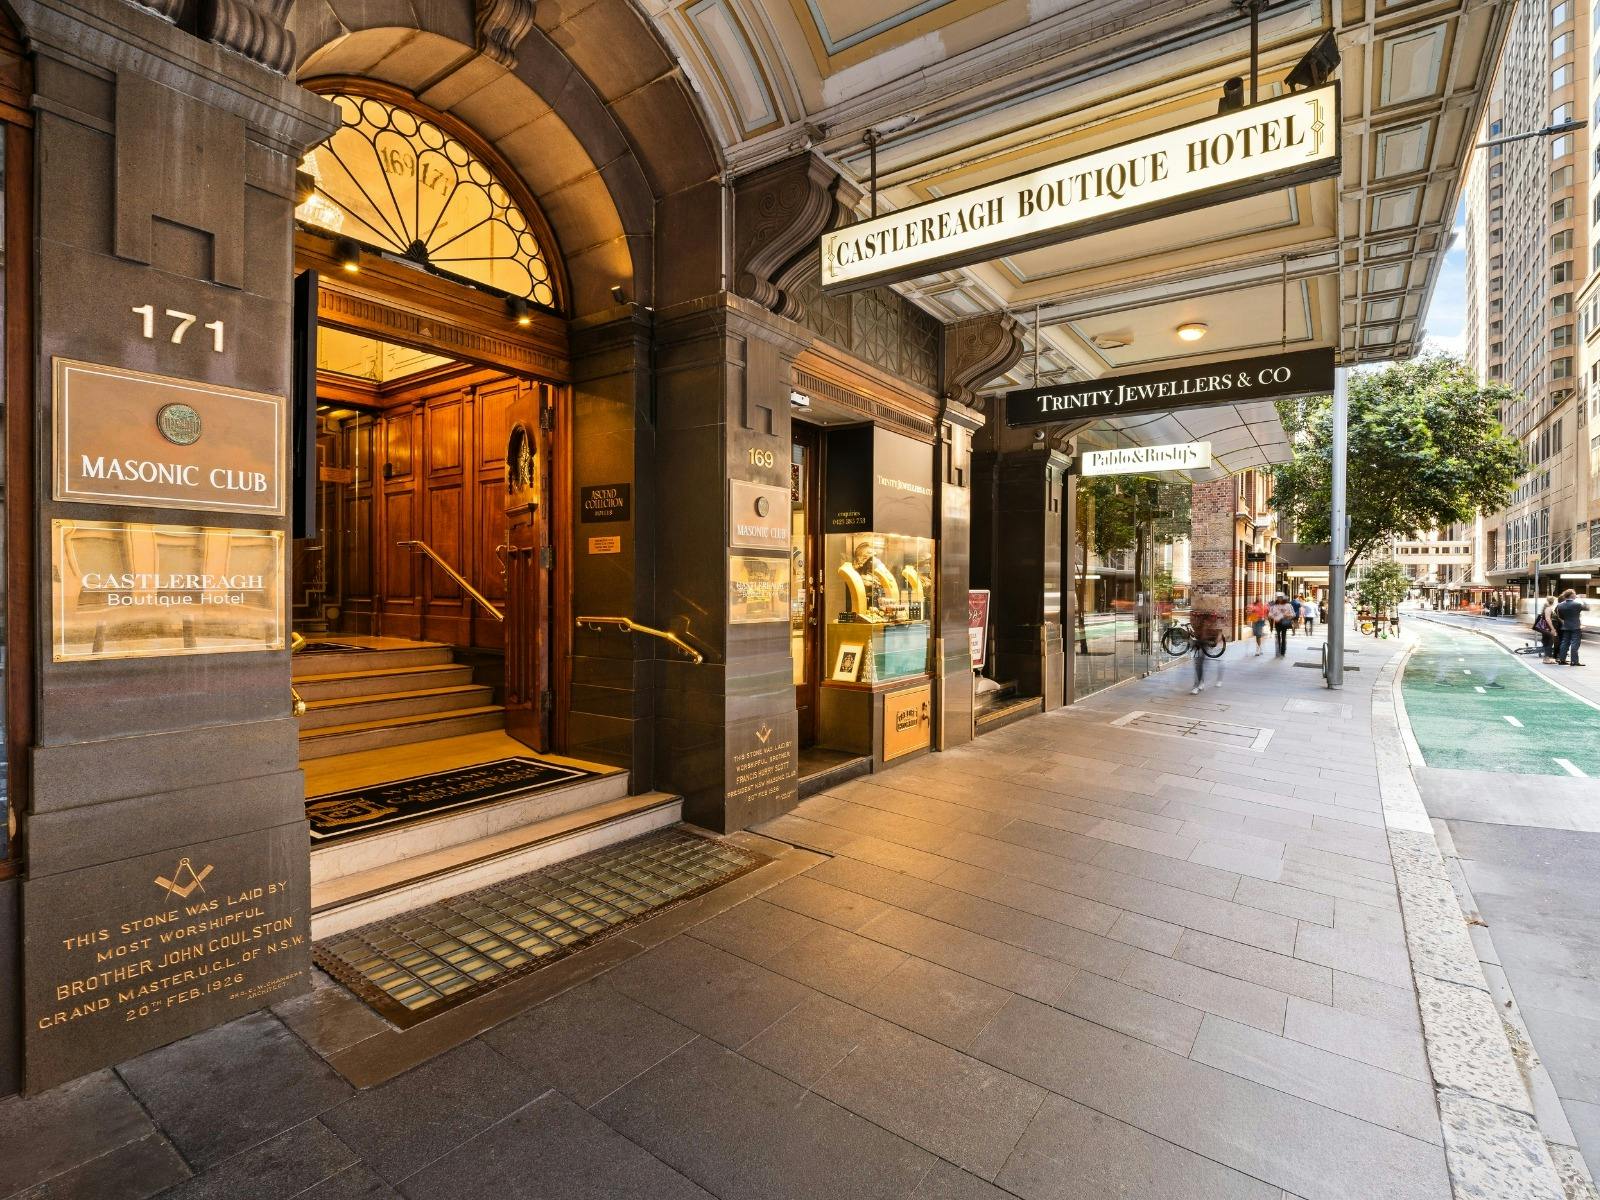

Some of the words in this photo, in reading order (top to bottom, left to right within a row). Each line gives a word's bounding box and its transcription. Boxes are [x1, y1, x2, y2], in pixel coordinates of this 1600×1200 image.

[381, 147, 415, 177] 169
[420, 163, 449, 196] 171
[836, 197, 1006, 267] CASTLEREAGH
[1017, 150, 1168, 218] BOUTIQUE
[1186, 114, 1306, 173] HOTEL
[132, 304, 224, 353] 171
[1237, 372, 1252, 387] &
[1258, 366, 1291, 385] CO
[749, 447, 774, 468] 169
[80, 454, 200, 487] MASONIC
[209, 468, 268, 493] CLUB
[585, 498, 624, 509] COLLECTION
[592, 489, 616, 499] ASCEND
[737, 524, 769, 538] MASONIC
[770, 527, 787, 539] CLUB
[81, 573, 264, 590] CASTLEREAGH
[107, 594, 193, 608] Boutique
[200, 593, 245, 605] Hotel
[774, 761, 789, 771] SCOTT
[62, 929, 110, 951] THIS
[121, 910, 180, 934] STONE
[185, 899, 220, 916] WAS
[227, 887, 263, 906] LAID
[268, 880, 288, 895] BY
[97, 938, 152, 963] MOST
[159, 907, 265, 944] WORSHIPFUL
[38, 997, 111, 1029] GRAND
[242, 948, 261, 963] OF
[266, 934, 305, 955] N.S.W.
[56, 959, 154, 1001] BROTHER
[158, 943, 204, 969] JOHN
[126, 999, 162, 1022] 20TH
[166, 988, 205, 1008] FEB.
[206, 973, 244, 994] 1926
